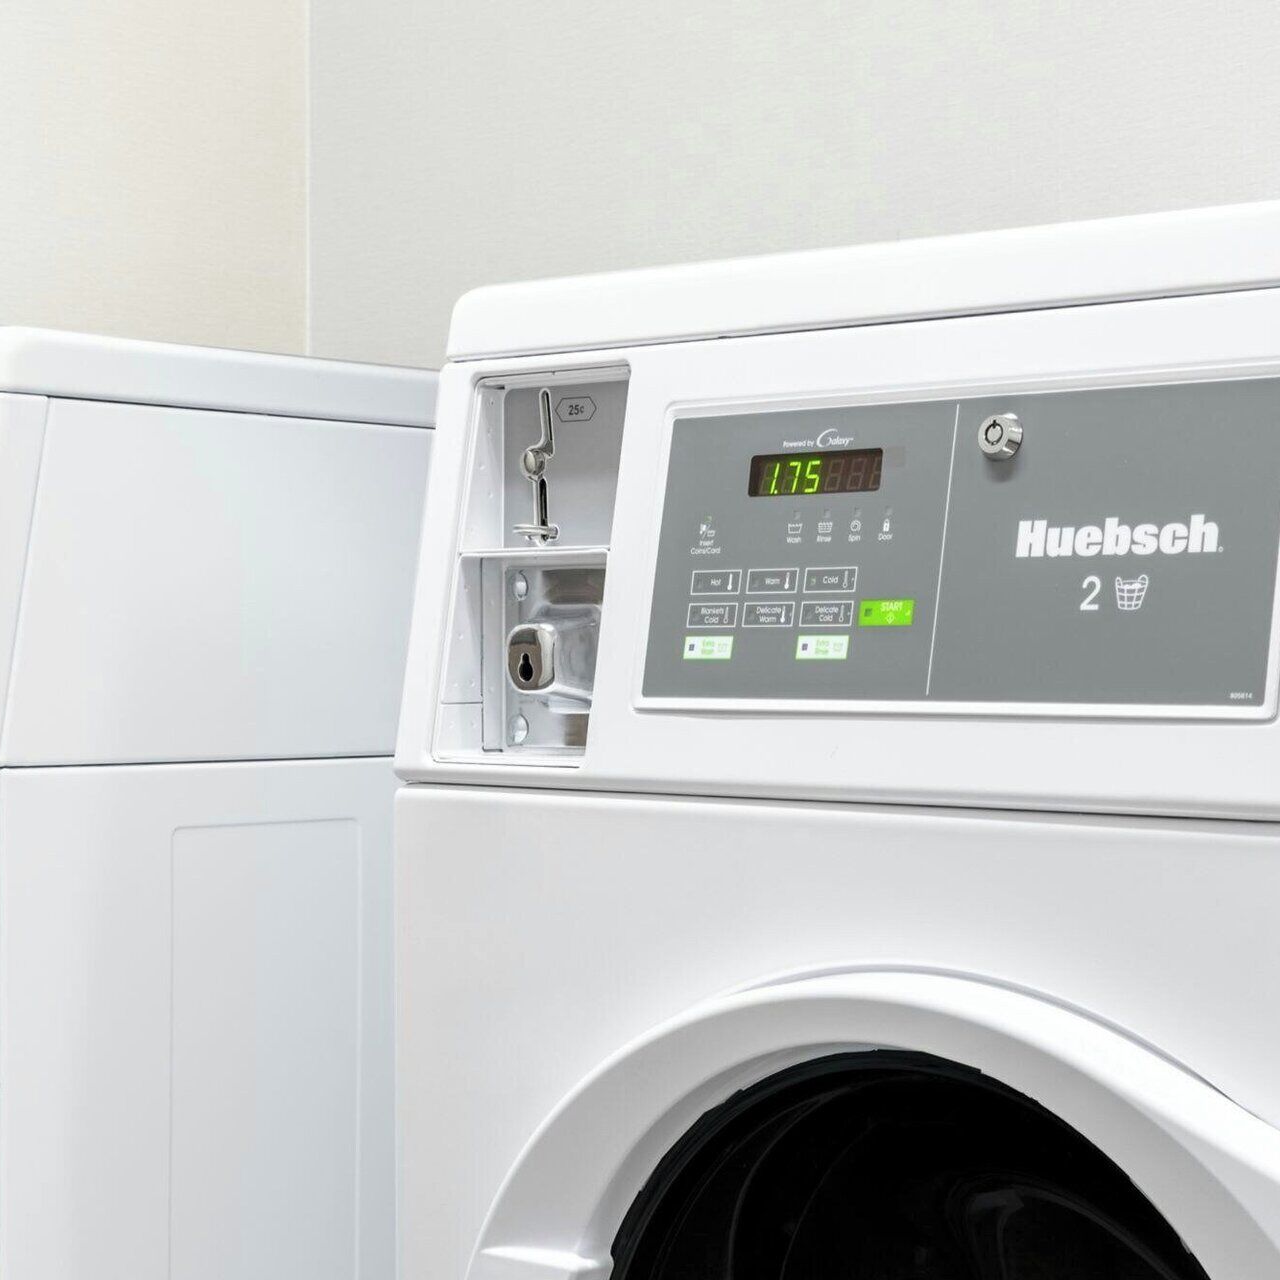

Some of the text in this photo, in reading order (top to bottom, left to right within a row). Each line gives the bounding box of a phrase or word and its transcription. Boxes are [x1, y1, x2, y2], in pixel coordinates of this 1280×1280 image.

[807, 438, 815, 448] by
[770, 460, 821, 495] 1.75
[878, 533, 893, 541] Door
[1015, 514, 1220, 557] Huebsch
[786, 536, 802, 544] Wash
[710, 578, 722, 586] Hot
[822, 576, 839, 584] Cold
[1079, 575, 1102, 611] 2
[756, 606, 781, 614] Delicate
[815, 606, 839, 614] Delicate
[881, 601, 904, 612] START
[704, 616, 719, 624] Cold
[819, 614, 833, 622] Cold
